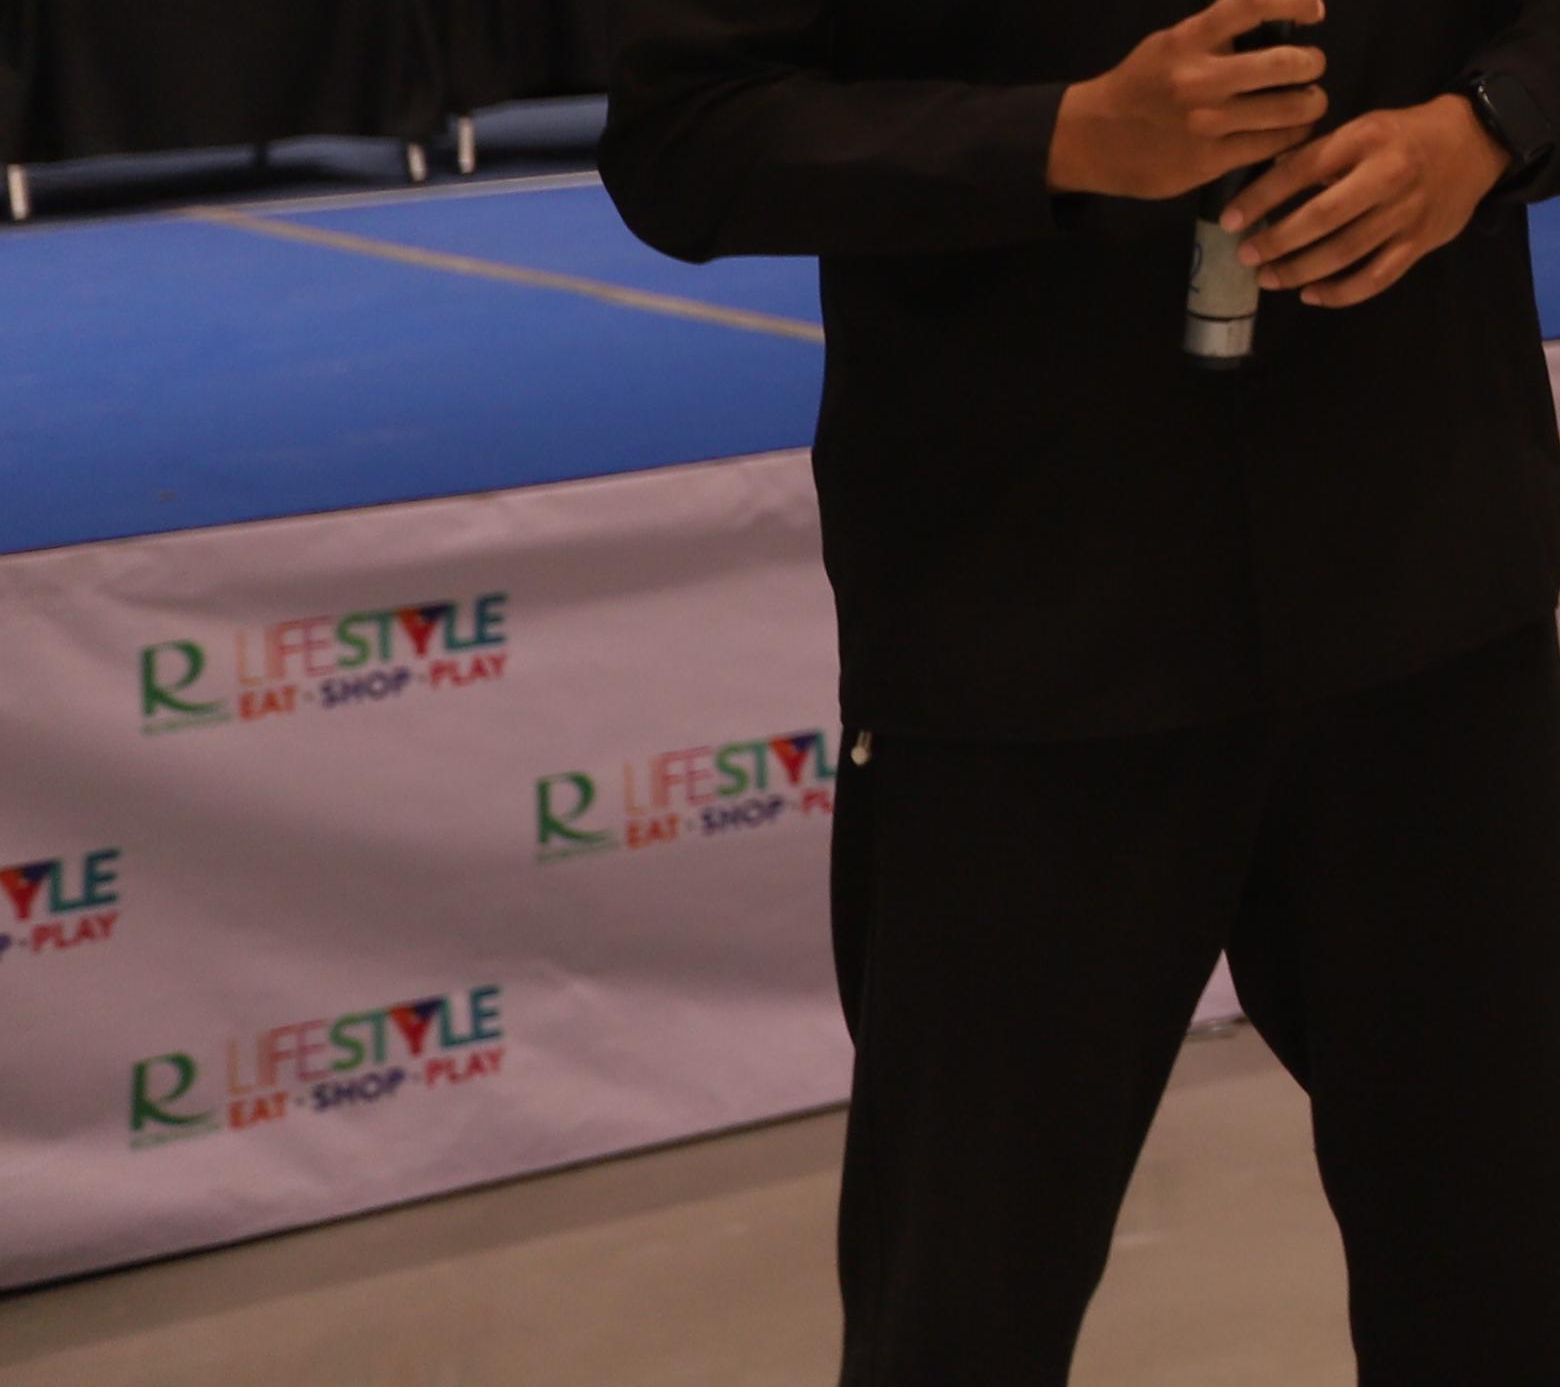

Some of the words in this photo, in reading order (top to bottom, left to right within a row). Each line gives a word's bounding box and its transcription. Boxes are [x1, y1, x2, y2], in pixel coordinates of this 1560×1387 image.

[140, 638, 229, 717] R
[235, 591, 508, 687] LIFESTYLE
[238, 685, 297, 721] EAT
[320, 667, 411, 709] SHOP
[428, 652, 507, 689] PLAY
[536, 771, 612, 845] R
[623, 729, 838, 817] LIFESTYL
[31, 910, 121, 955] PLAY
[130, 1052, 217, 1132] R
[225, 985, 503, 1097] LIFESTYLE
[227, 1092, 289, 1131] EAT
[312, 1068, 405, 1111] SHOP
[425, 1047, 506, 1088] PLAY
